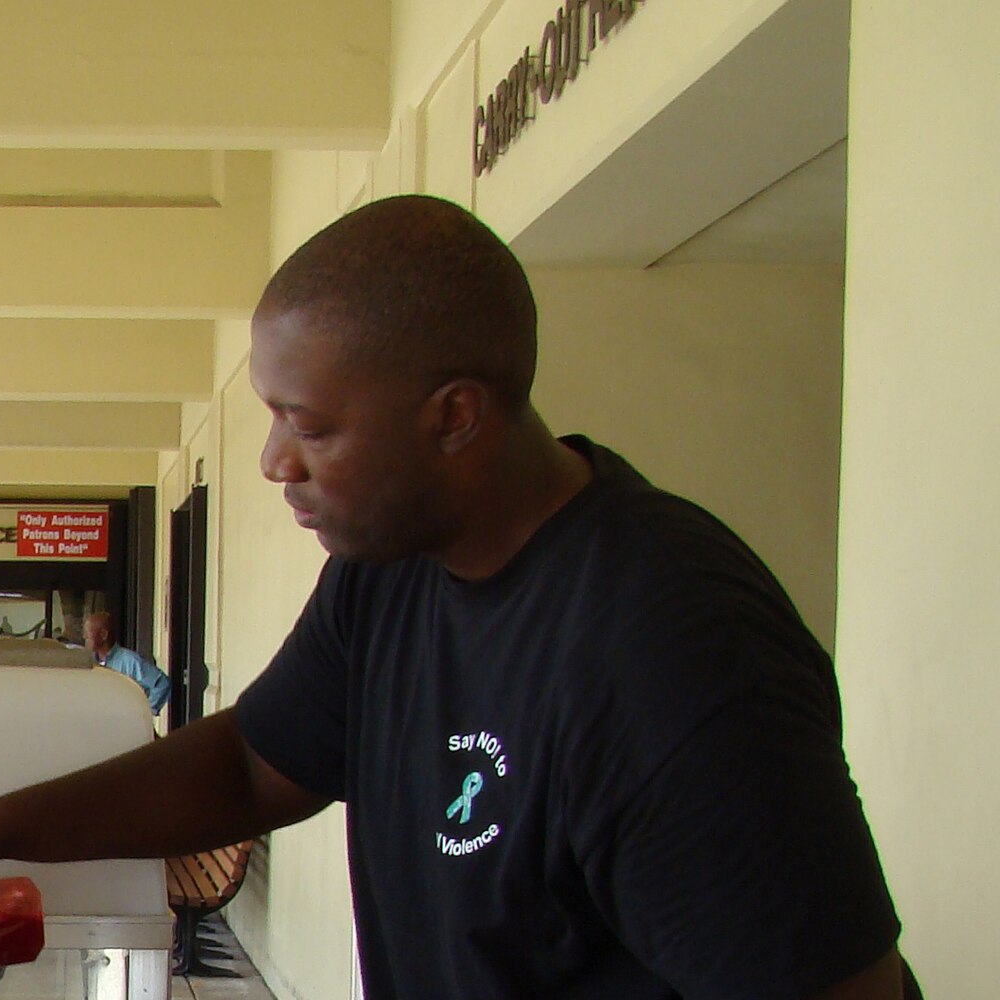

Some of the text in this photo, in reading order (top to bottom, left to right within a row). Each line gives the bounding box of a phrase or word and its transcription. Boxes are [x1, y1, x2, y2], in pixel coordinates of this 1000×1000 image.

[51, 515, 103, 526] Authorized
[22, 529, 99, 541] Patrons Beyond
[33, 543, 54, 554] This
[448, 731, 506, 777] Say NO! to
[441, 823, 500, 856] Violence
